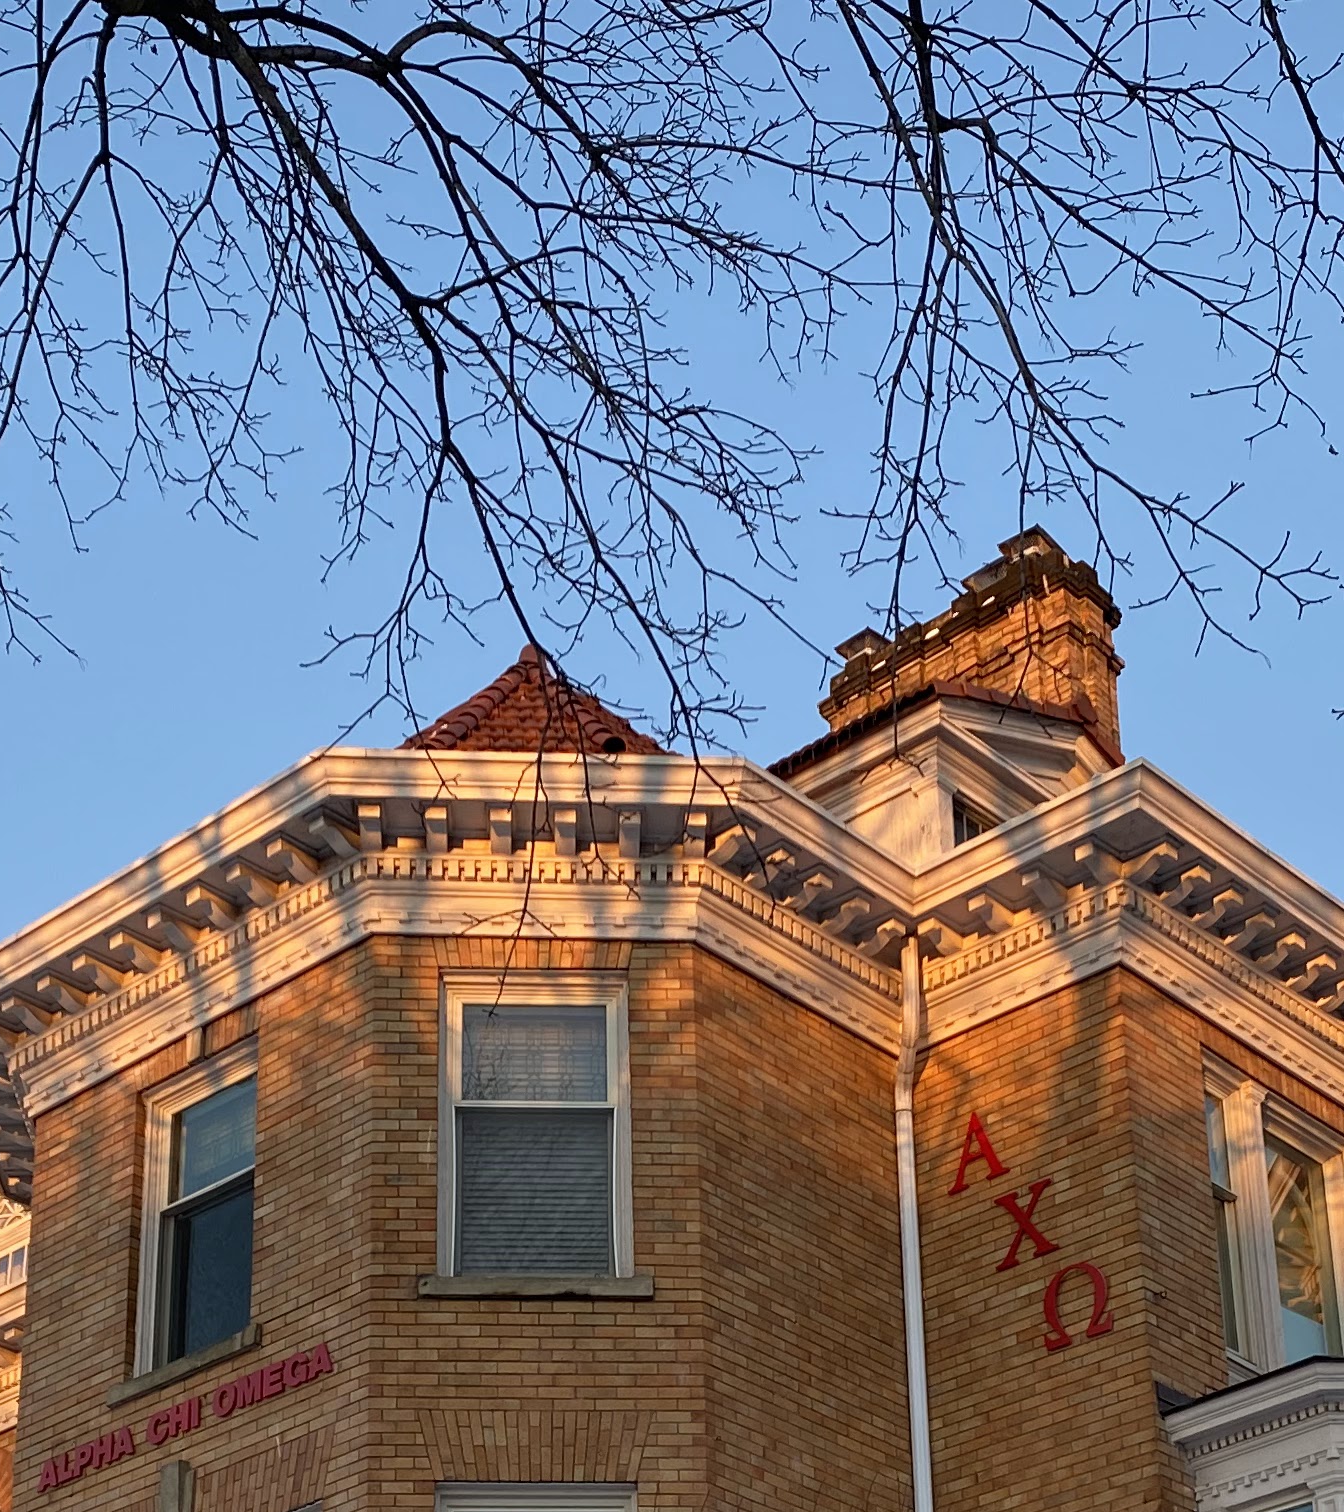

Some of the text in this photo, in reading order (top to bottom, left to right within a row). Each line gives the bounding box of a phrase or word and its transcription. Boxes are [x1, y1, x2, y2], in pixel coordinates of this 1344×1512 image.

[37, 1342, 334, 1492] ALPHA CHI OMEGA
